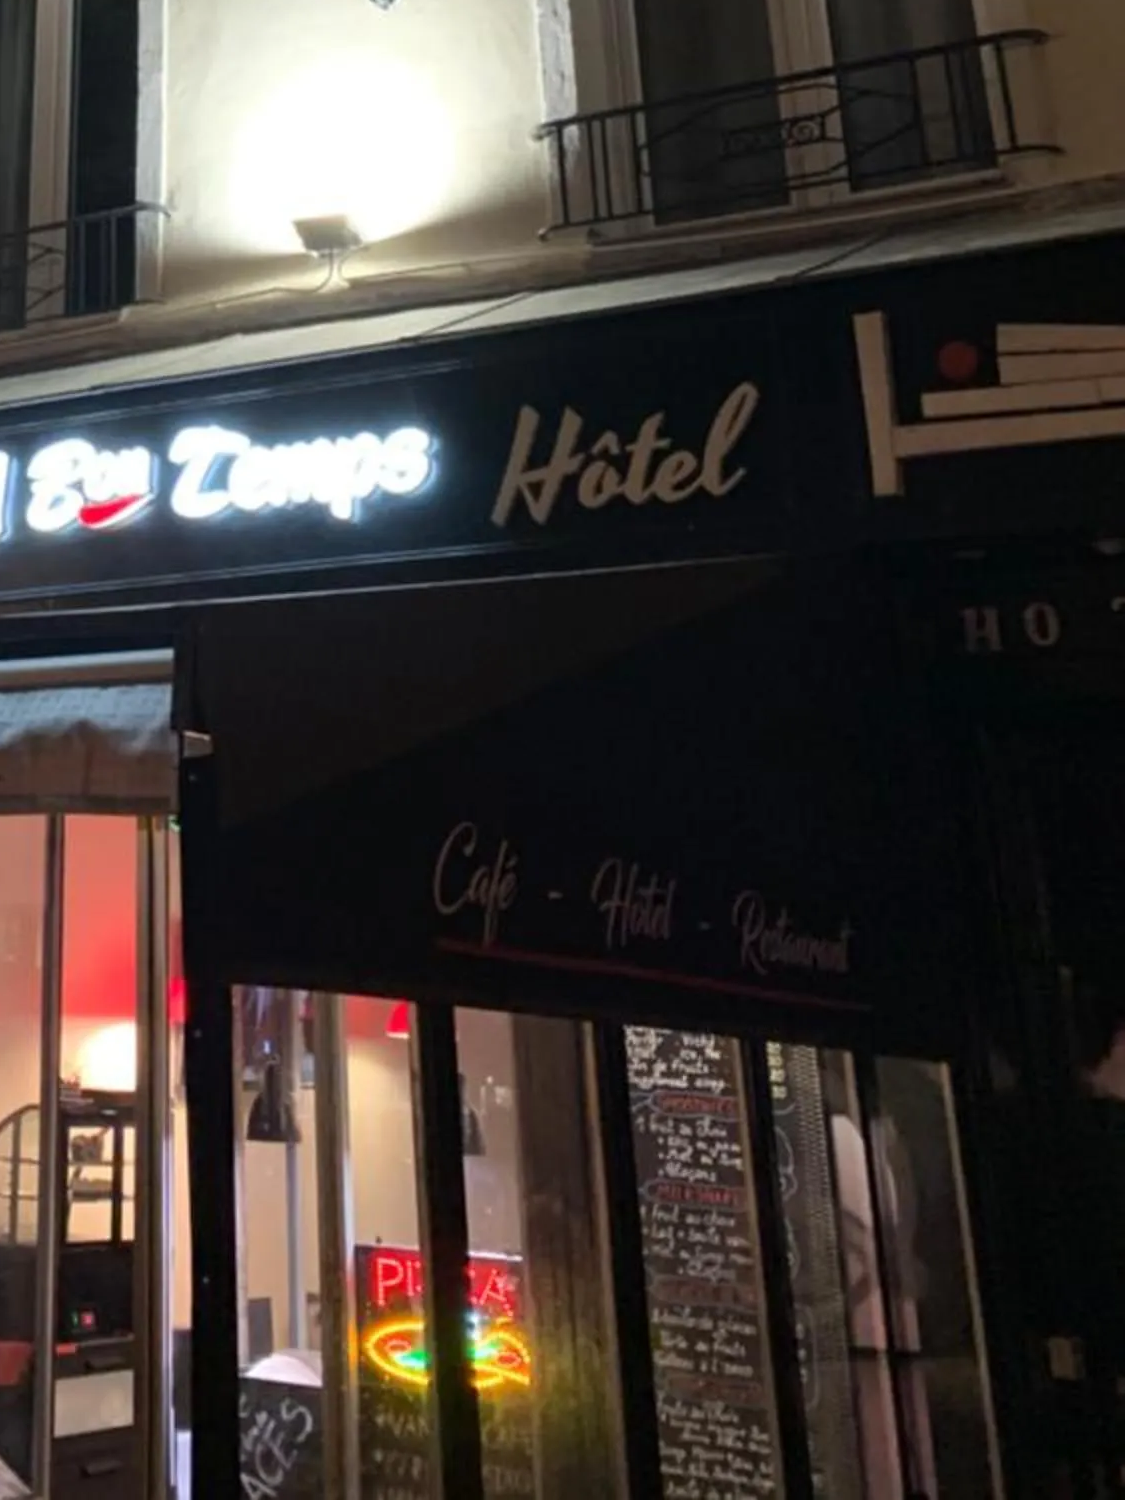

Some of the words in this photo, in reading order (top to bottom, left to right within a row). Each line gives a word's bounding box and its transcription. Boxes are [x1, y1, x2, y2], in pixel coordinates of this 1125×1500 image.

[491, 381, 759, 528] Hôtel
[432, 821, 520, 947] Café
[375, 1257, 515, 1317] PIA
